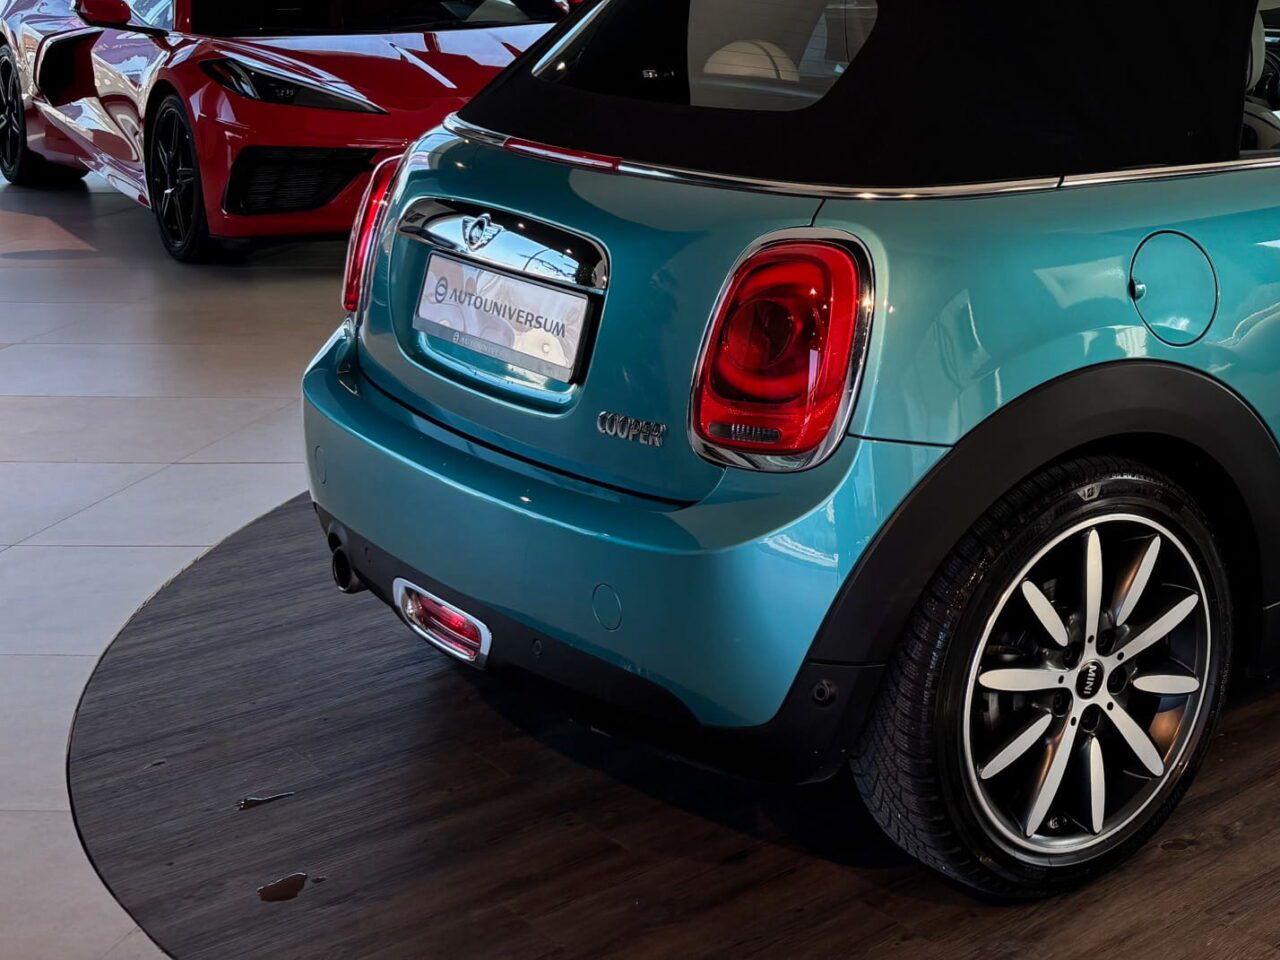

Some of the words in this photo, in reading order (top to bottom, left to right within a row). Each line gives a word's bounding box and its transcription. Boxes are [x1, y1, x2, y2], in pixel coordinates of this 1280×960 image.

[449, 287, 566, 338] AUTOUNIVERSUM
[597, 411, 667, 447] COOPER
[1083, 664, 1097, 694] MINI
